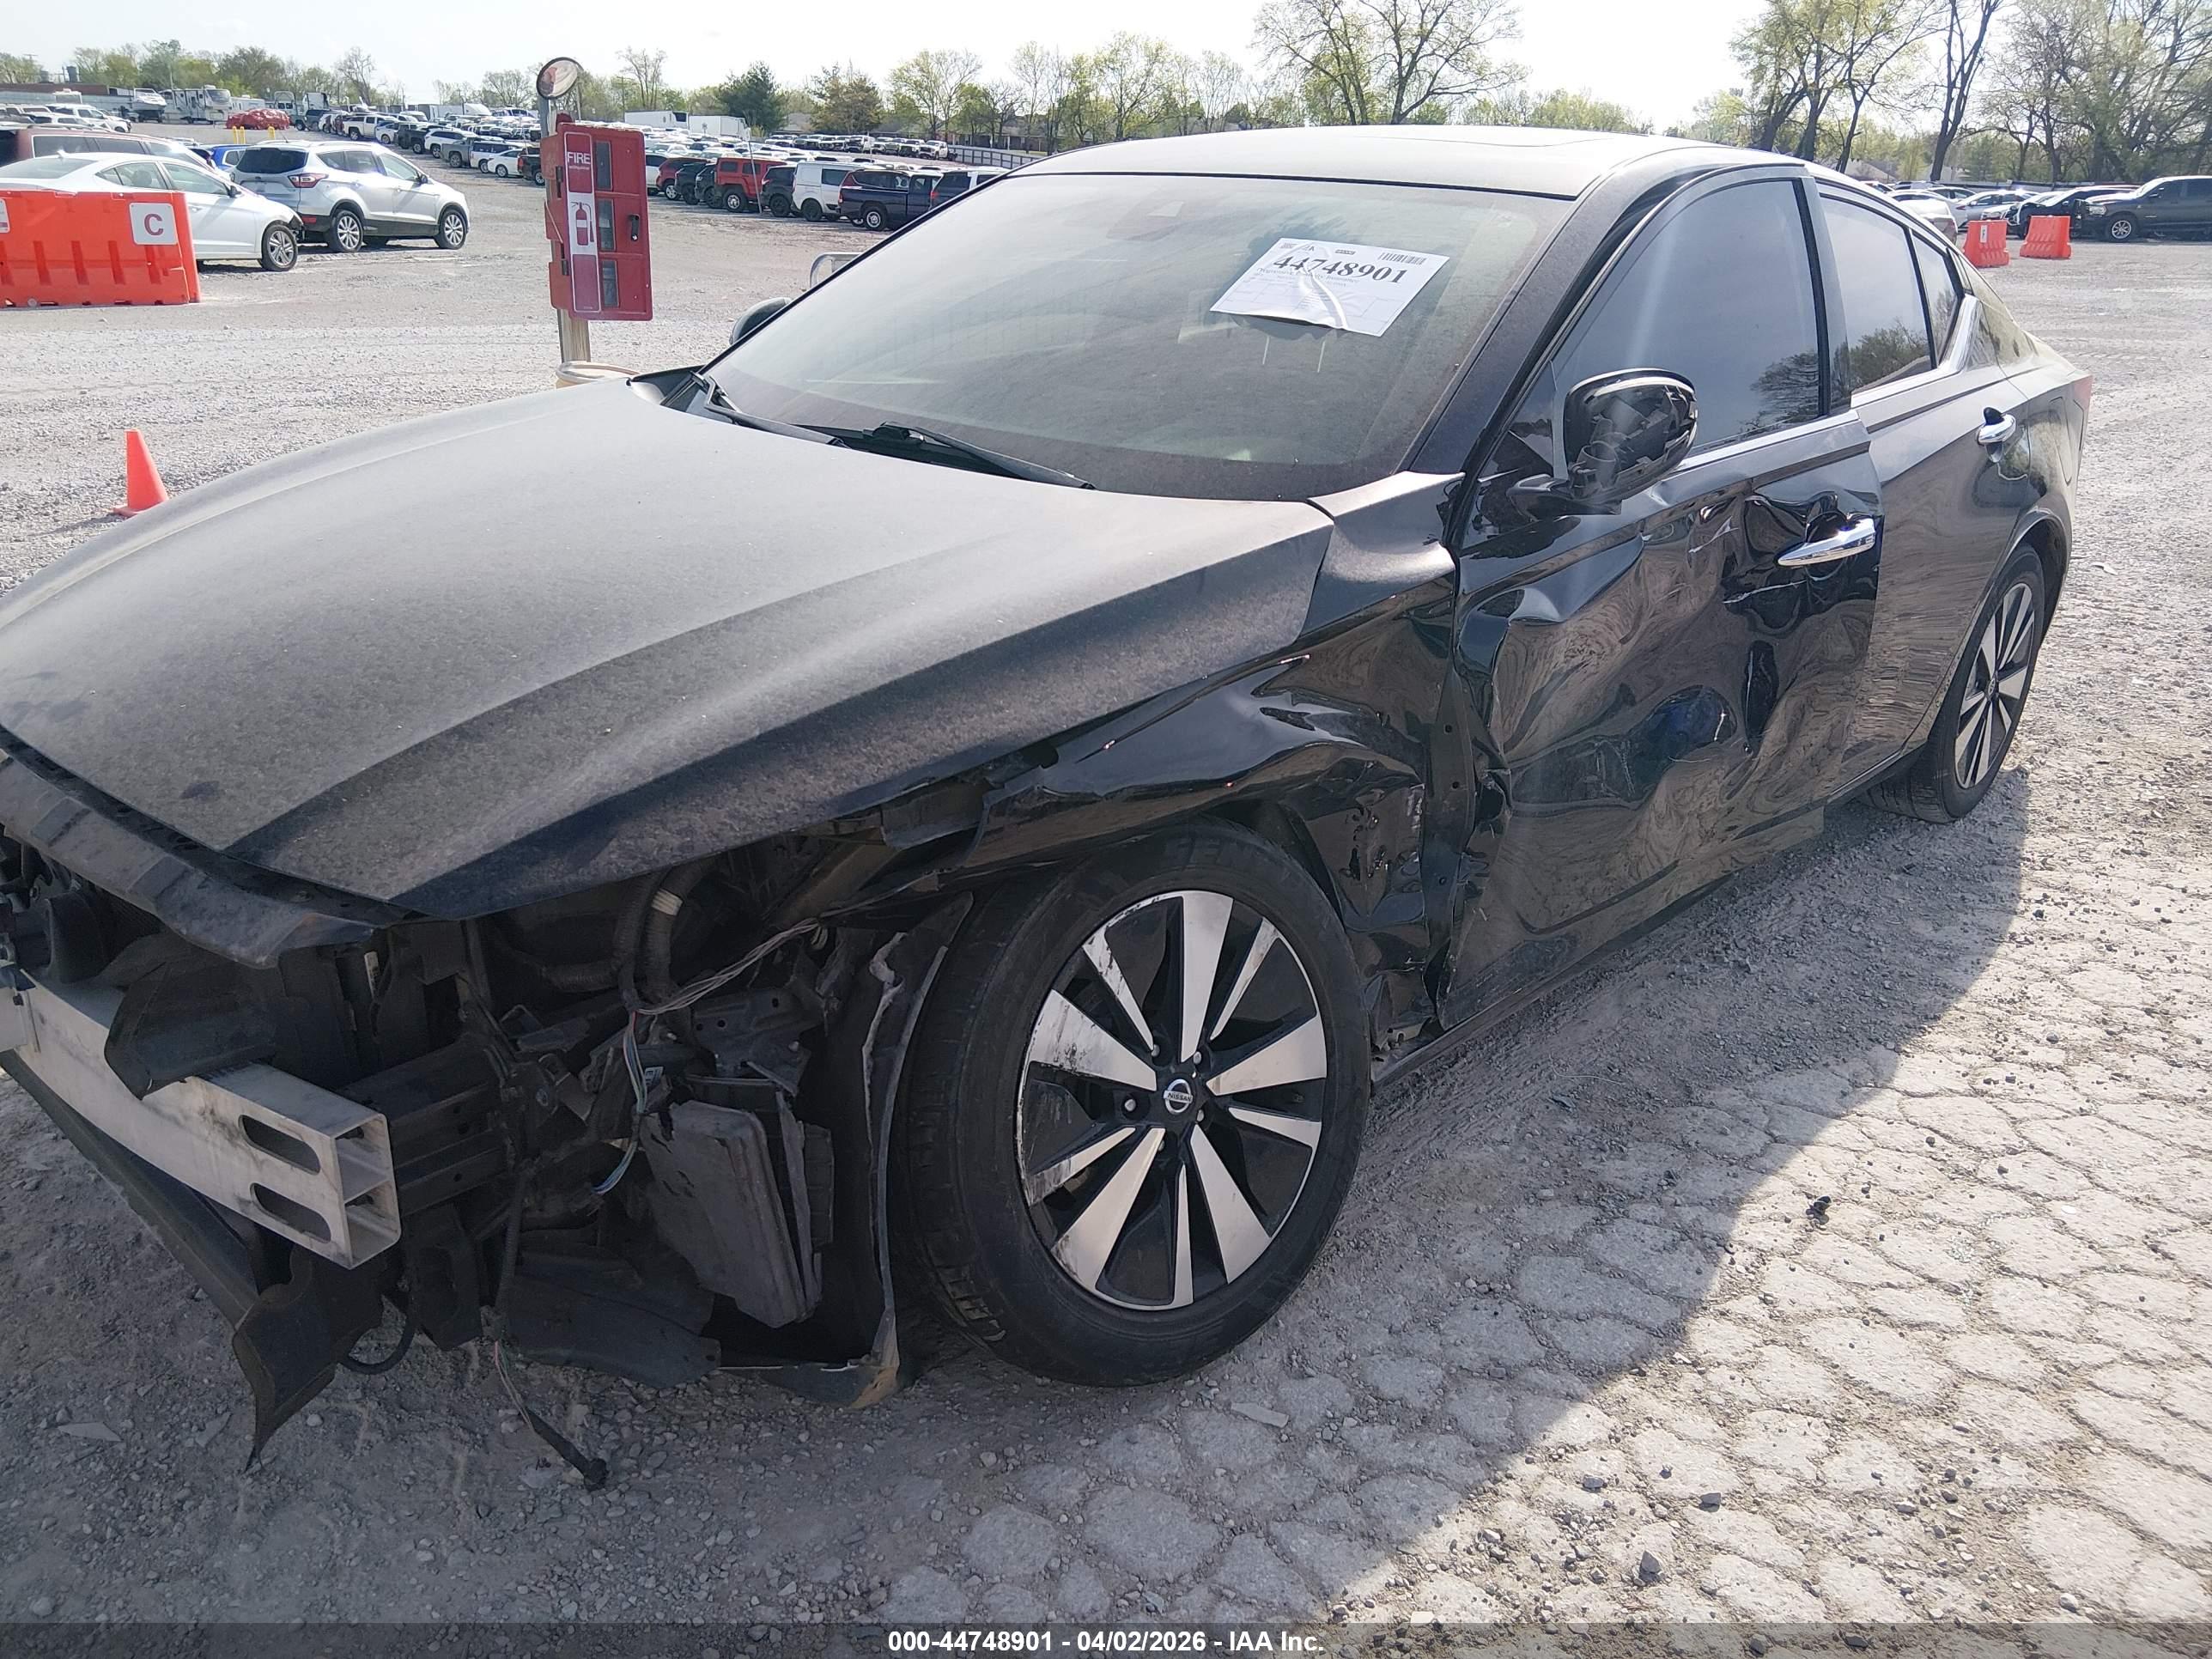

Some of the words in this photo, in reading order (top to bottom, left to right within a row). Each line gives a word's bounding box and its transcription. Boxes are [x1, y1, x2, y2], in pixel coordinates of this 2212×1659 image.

[567, 151, 591, 164] FIRE
[143, 213, 164, 236] C
[1273, 256, 1408, 284] 44748901
[1167, 1091, 1192, 1102] NISSAN
